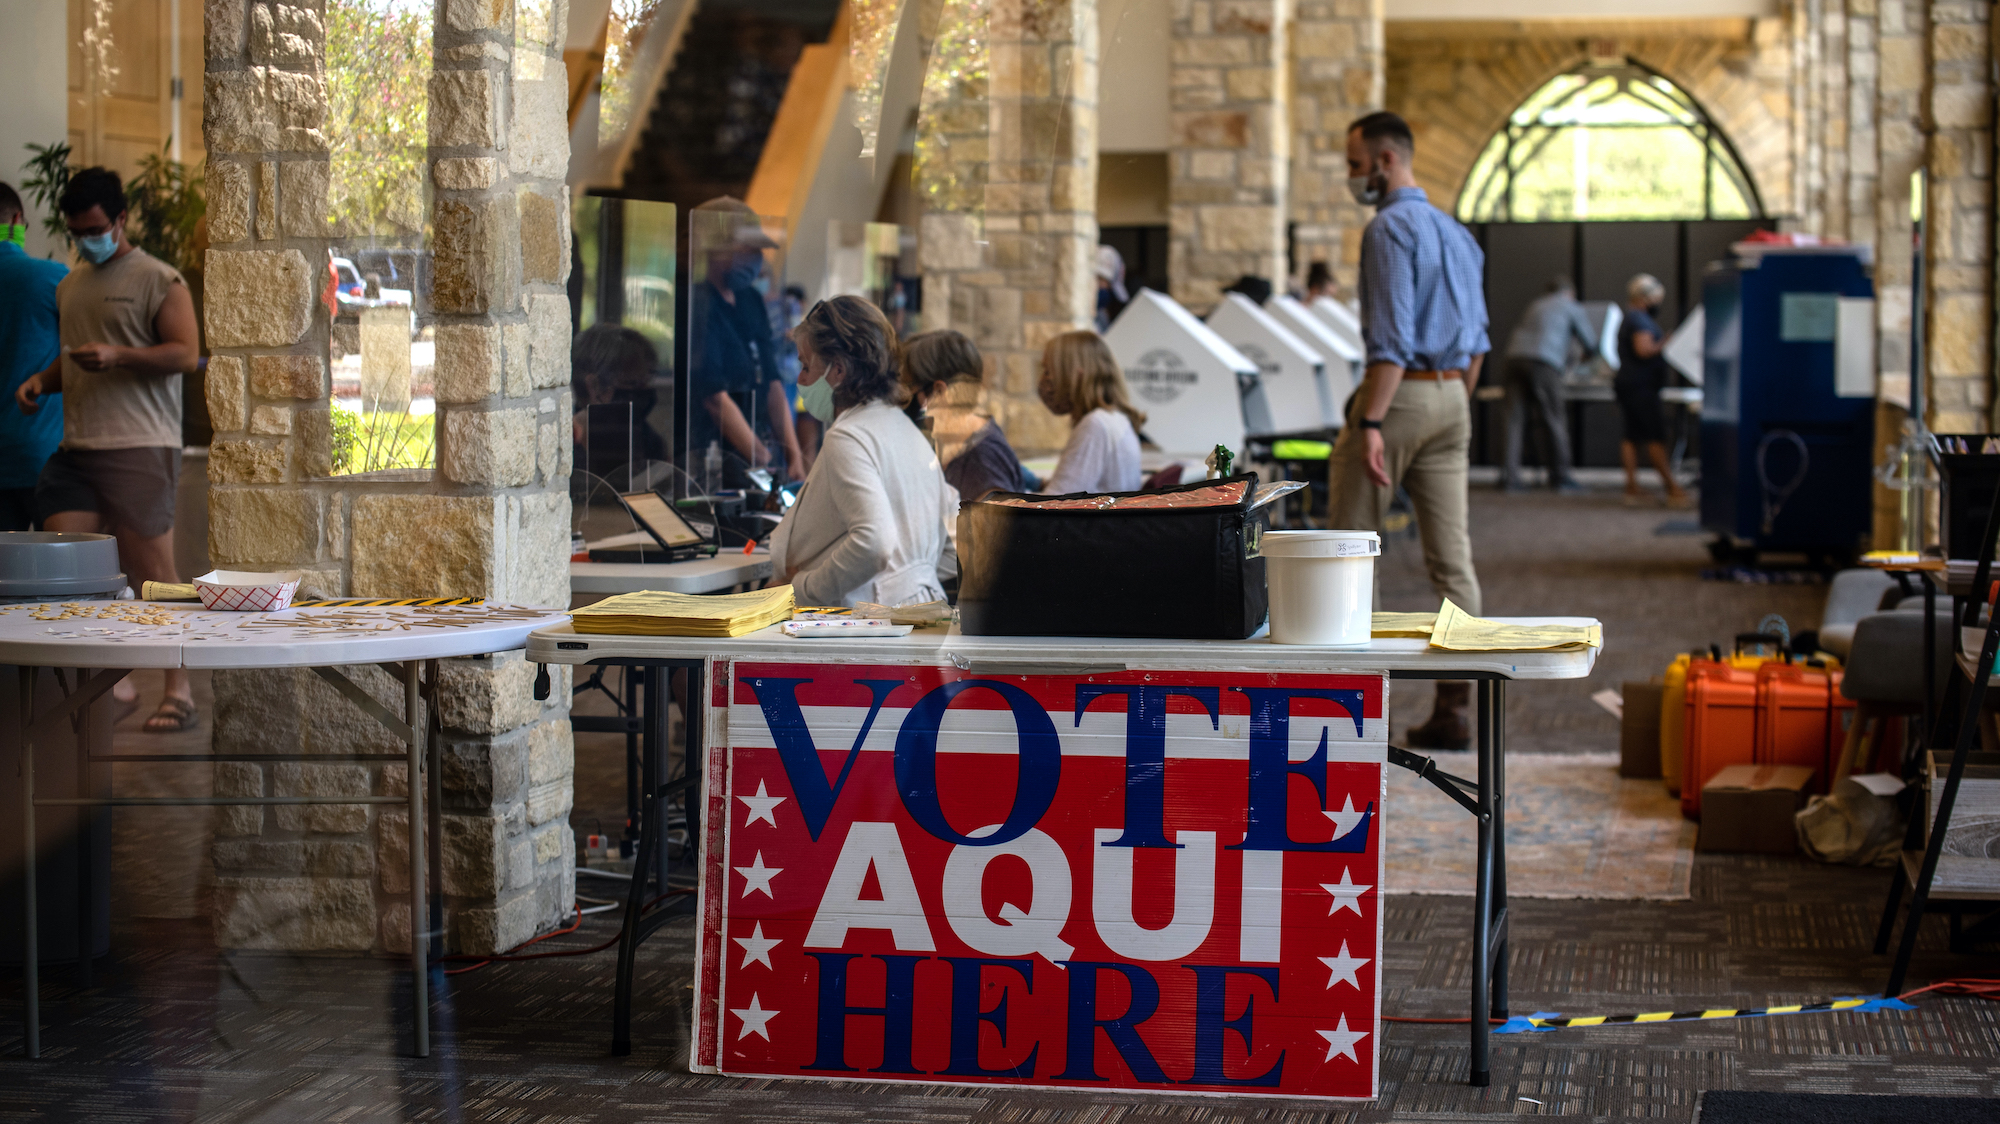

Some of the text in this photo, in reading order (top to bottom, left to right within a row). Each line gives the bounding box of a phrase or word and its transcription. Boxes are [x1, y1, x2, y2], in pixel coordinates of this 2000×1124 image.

[738, 677, 1374, 854] VOTE
[803, 821, 1285, 970] AQUI
[799, 952, 1286, 1088] HERE
